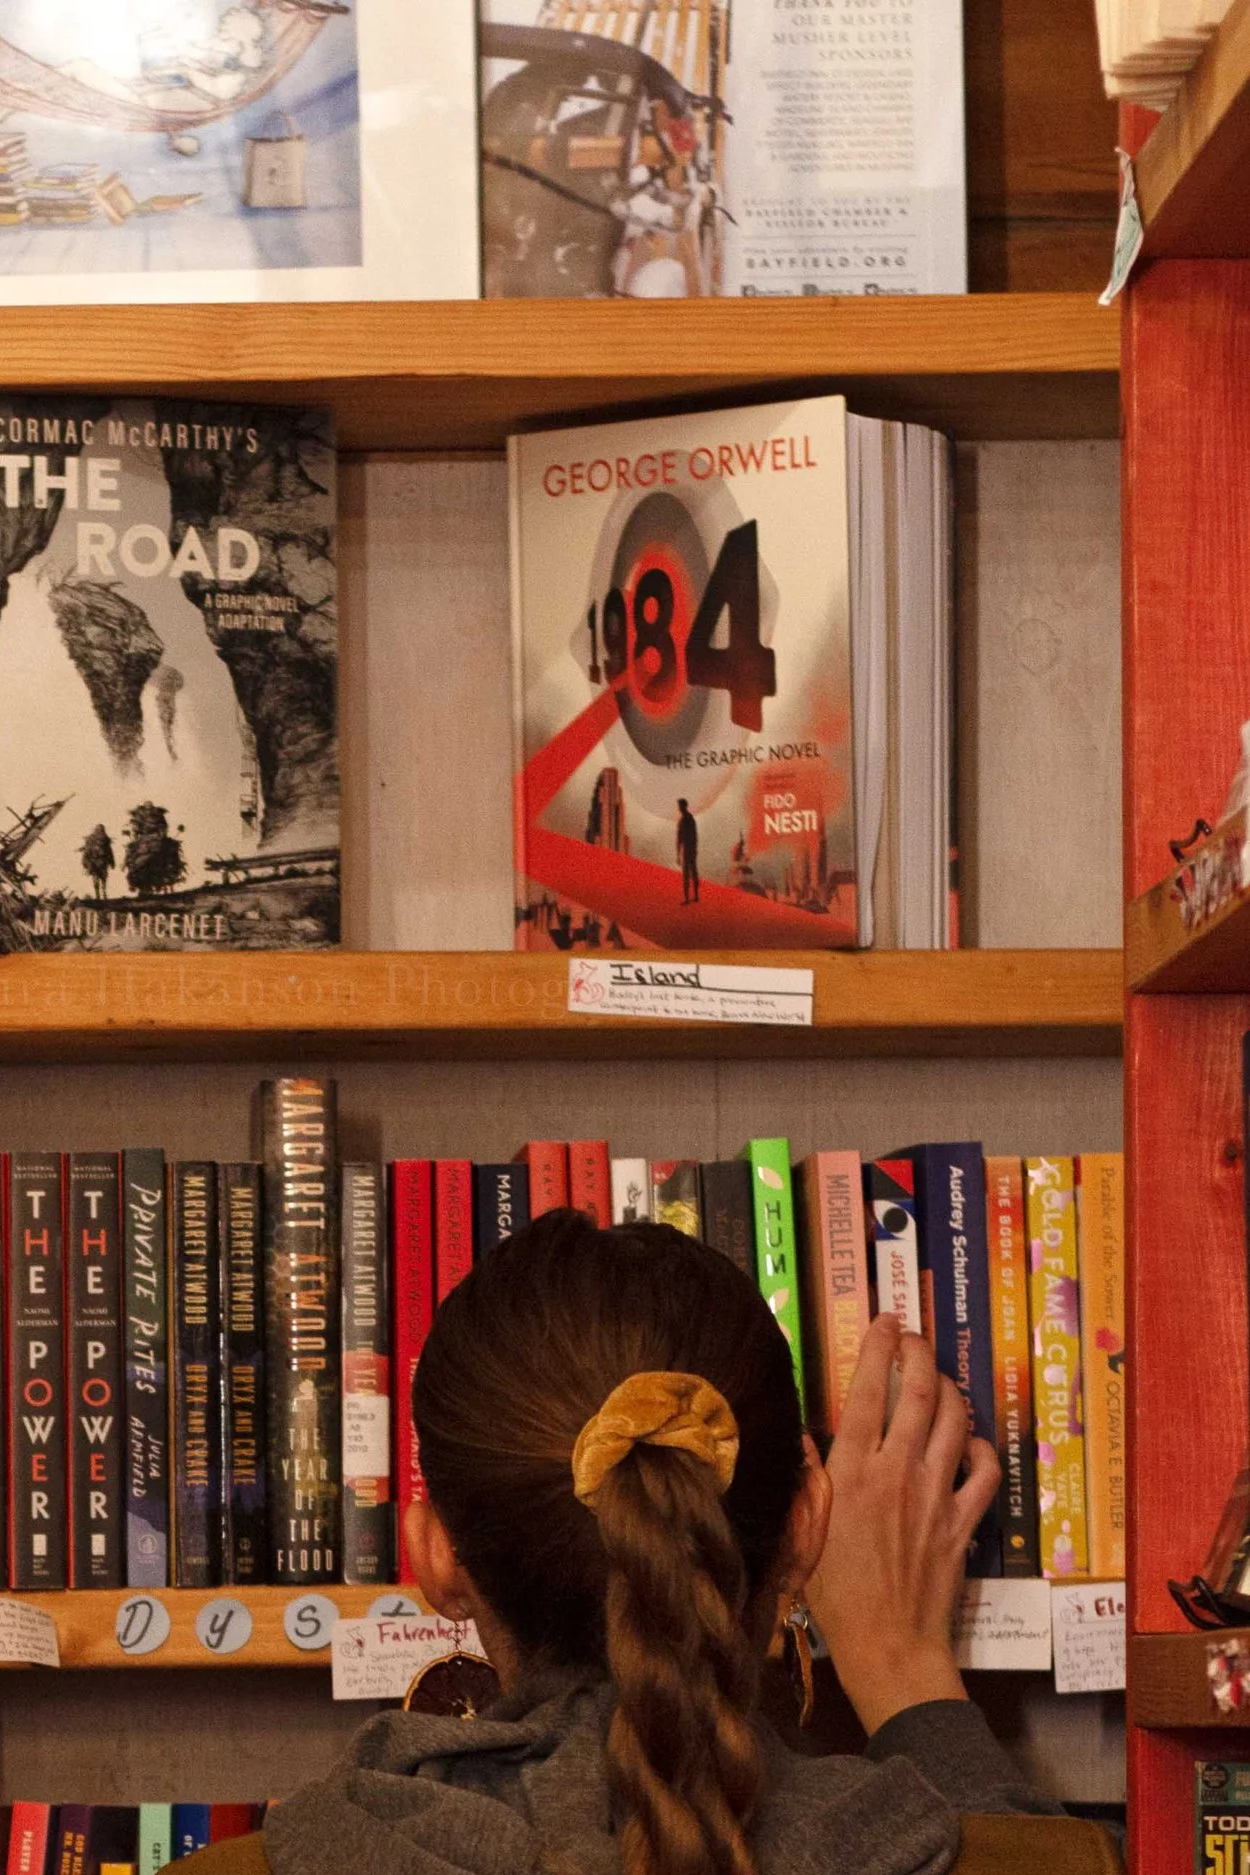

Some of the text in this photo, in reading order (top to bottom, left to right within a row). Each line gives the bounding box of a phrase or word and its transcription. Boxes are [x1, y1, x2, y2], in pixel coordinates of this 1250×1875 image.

[818, 49, 914, 60] SPONSORS
[745, 256, 907, 269] BAYFIELD.ORG
[108, 420, 260, 454] McCARTHY'S
[542, 434, 818, 497] GEORGE ORWELL
[76, 523, 261, 582] ROAD
[665, 740, 821, 770] THE GRAPHIC NOVEL
[764, 810, 817, 835] NESTI
[32, 910, 228, 940] MANU LARCENET
[609, 963, 701, 987] Island
[950, 1165, 966, 1231] Audrey
[1040, 1164, 1063, 1248] GOLD
[23, 1191, 49, 1294] THE
[82, 1191, 107, 1294] THE
[184, 1175, 207, 1324] MARGARET ATWOOD
[352, 1175, 376, 1326] MARGARET ATWOOD
[764, 1201, 787, 1277] HUM
[826, 1174, 857, 1296] MICHELLE TEA
[998, 1175, 1015, 1340] THE BOOK OF JOAN
[1101, 1167, 1117, 1319] Parable of the Sower
[129, 1182, 161, 1394] PRIVATE RITES
[288, 1252, 327, 1371] ATWOOD
[950, 1235, 970, 1324] Schulman
[1044, 1257, 1066, 1334] FAME
[22, 1341, 55, 1519] POWER
[81, 1341, 113, 1519] POWER
[185, 1364, 208, 1487] ORYX AND CRAKE
[289, 1428, 320, 1450] THE
[1004, 1356, 1023, 1517] LIDIA YUKNAVITCH
[1106, 1381, 1122, 1452] OCTAVIA
[128, 1416, 147, 1497] ARMFIELD
[147, 1434, 164, 1479] JULIA
[282, 1459, 328, 1481] YEAR
[289, 1519, 321, 1542] THE
[295, 1489, 316, 1511] OF
[1108, 1475, 1124, 1530] BUTLER
[277, 1550, 334, 1572] FLOOD
